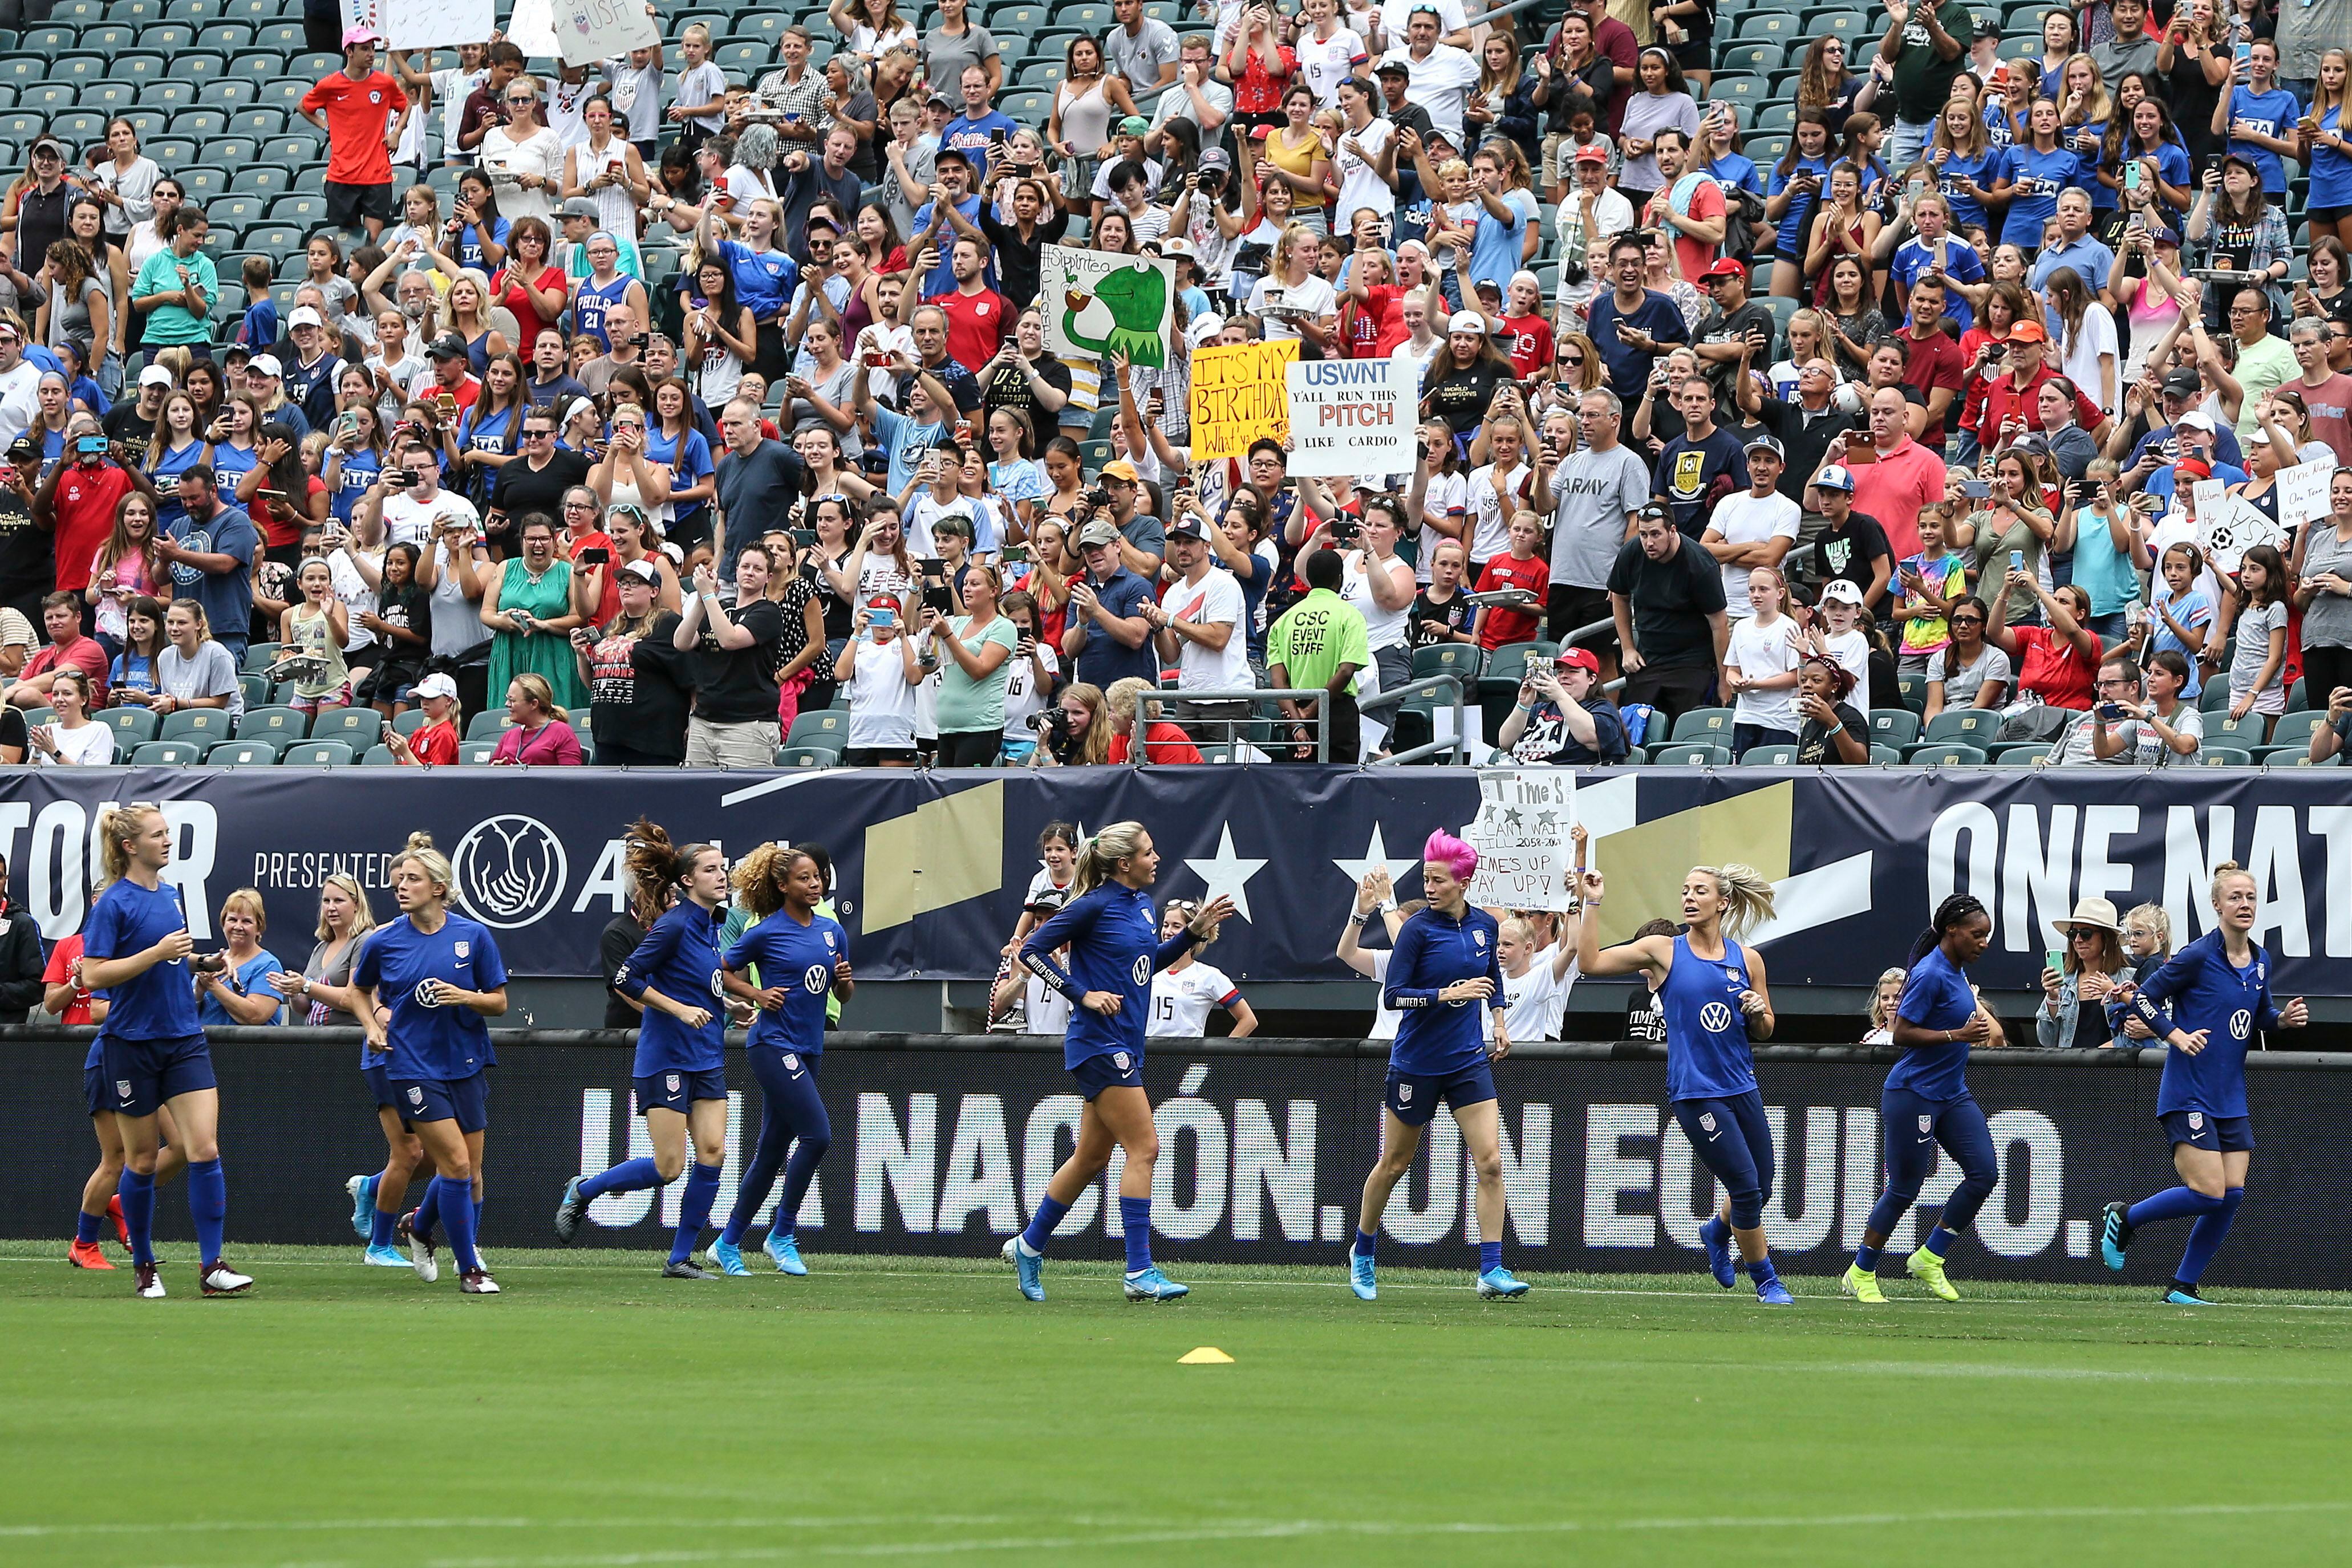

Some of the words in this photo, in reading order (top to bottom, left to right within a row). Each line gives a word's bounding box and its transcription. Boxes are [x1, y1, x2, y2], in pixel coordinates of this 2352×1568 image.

[1309, 64, 1321, 78] 15
[618, 85, 634, 97] USA
[577, 295, 611, 311] PHILA
[584, 312, 599, 330] 21
[1194, 354, 1247, 387] IT'S
[1305, 361, 1391, 385] USWNT
[1292, 389, 1327, 403] Y'ALL
[1337, 391, 1364, 401] RUN
[1369, 389, 1397, 401] THIS
[1318, 402, 1393, 427] PITCH
[1304, 435, 1335, 448] LIKE
[1347, 434, 1397, 448] CARDIO
[1202, 472, 1223, 497] 20
[1562, 478, 1609, 495] ARMY
[415, 524, 429, 541] 16
[1827, 584, 1847, 594] USA
[1294, 610, 1330, 627] CSC
[1292, 628, 1327, 642] EVENT
[1292, 642, 1325, 656] STAFF
[1007, 676, 1023, 696] 16
[1531, 822, 1568, 835] WAIT
[1477, 855, 1522, 874] IME'S
[1528, 856, 1551, 871] UP
[1512, 875, 1550, 895] UP!
[1927, 801, 2140, 953] ONE
[1155, 996, 1174, 1021] 15
[1395, 997, 1418, 1008] UNITED
[1646, 1025, 1666, 1042] UP
[1380, 1100, 1552, 1246] UN
